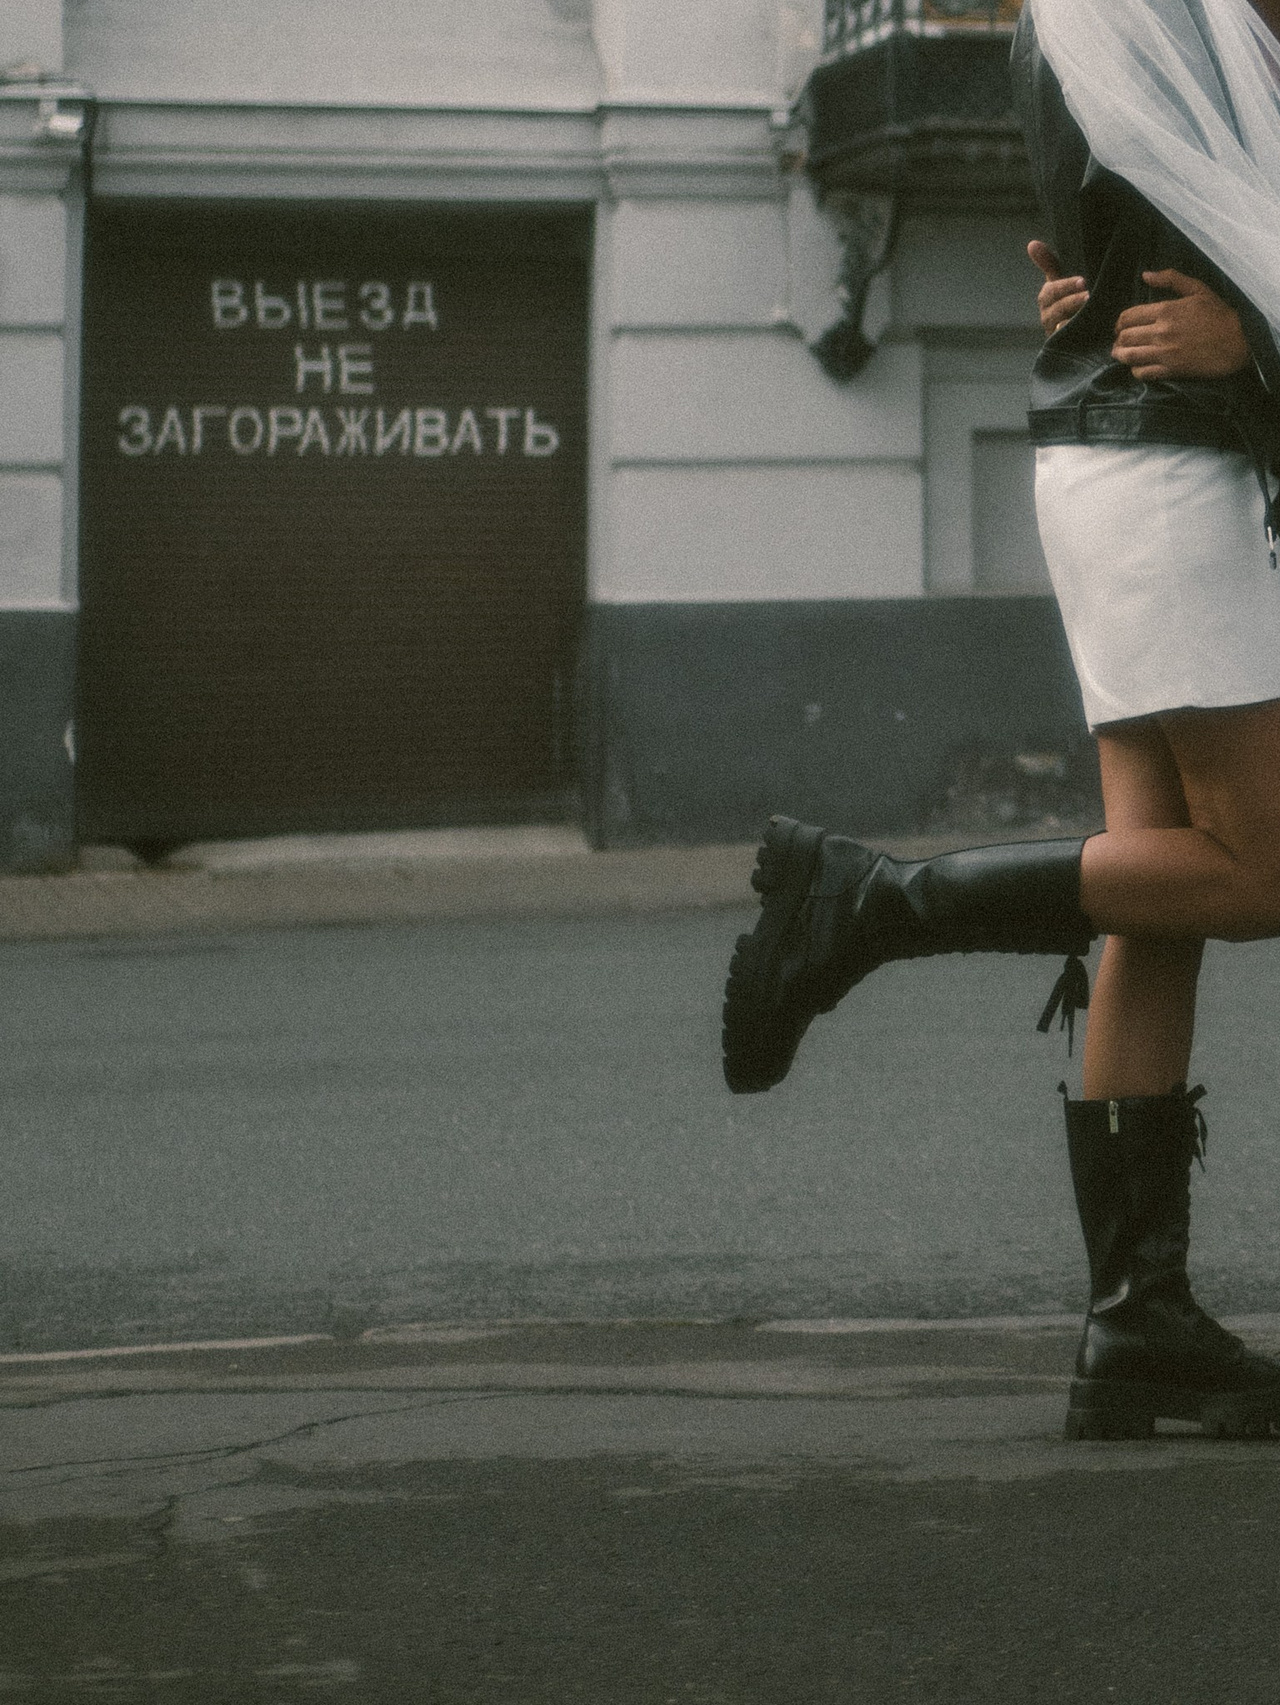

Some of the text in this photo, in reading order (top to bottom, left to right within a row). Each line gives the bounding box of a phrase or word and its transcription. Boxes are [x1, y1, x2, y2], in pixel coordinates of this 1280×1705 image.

[211, 280, 438, 330] ВЫЕЗД
[295, 343, 375, 394] НЕ
[117, 405, 560, 455] ЗАГОРАЖИВАТЬ
